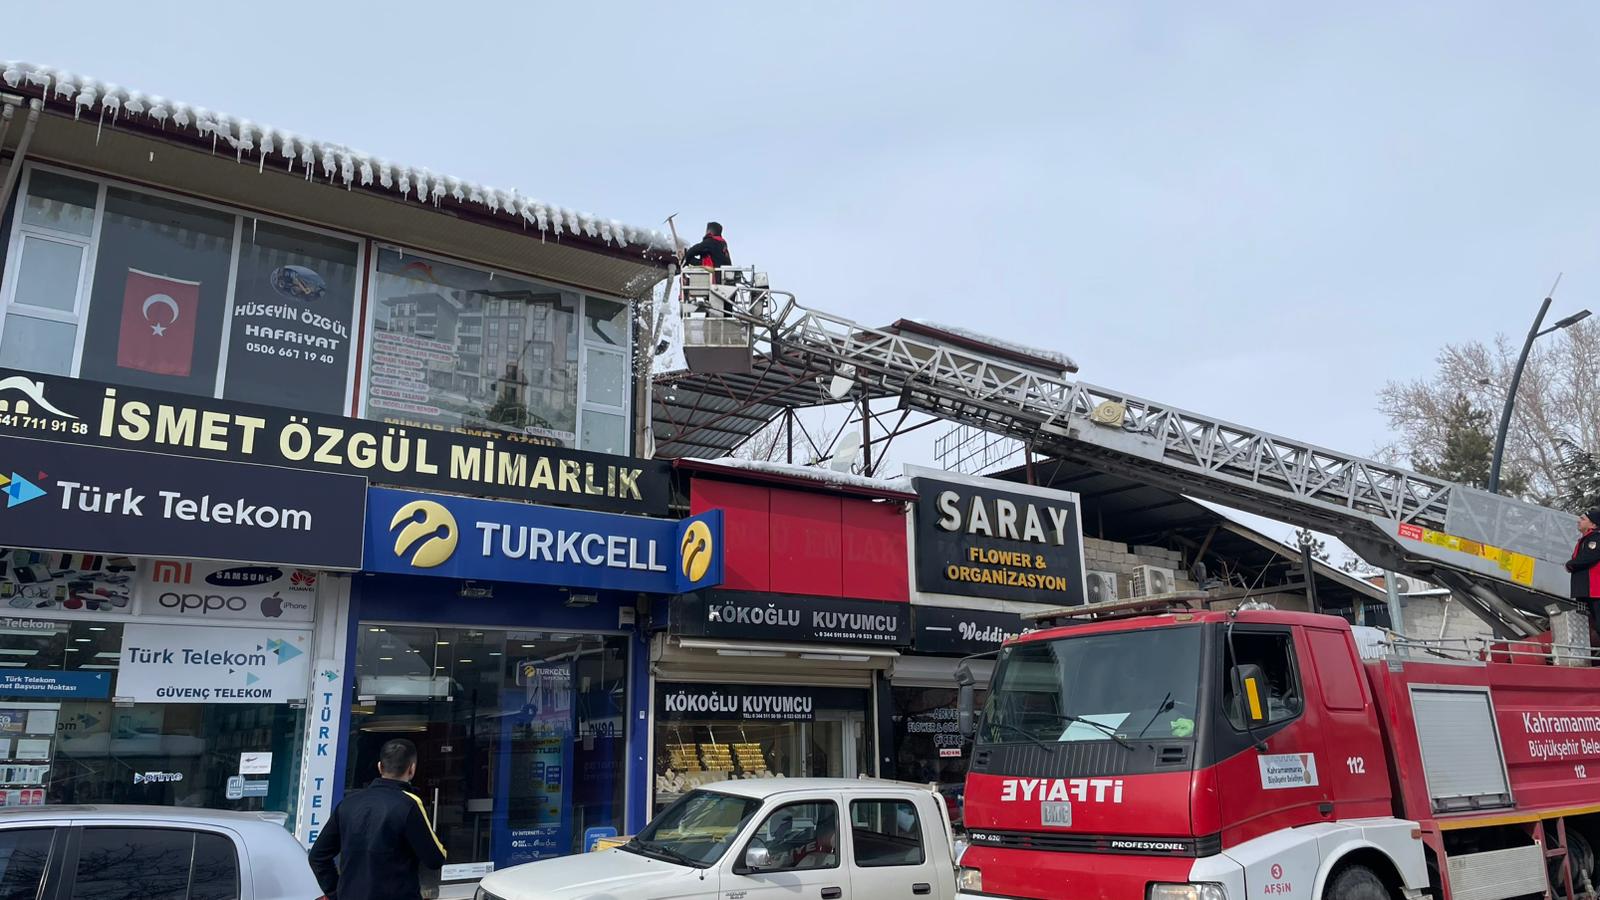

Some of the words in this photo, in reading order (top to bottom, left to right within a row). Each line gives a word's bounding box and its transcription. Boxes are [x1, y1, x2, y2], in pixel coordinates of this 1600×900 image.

[234, 302, 297, 320] HÜSEYİN
[301, 309, 348, 339] ÖZGÜL
[245, 324, 340, 350] HAFRİYAT
[246, 343, 275, 354] 0506
[278, 348, 299, 359] 667
[304, 351, 317, 361] 19
[320, 355, 334, 364] 40
[0, 414, 18, 427] 41
[22, 416, 47, 429] 711
[51, 420, 67, 432] 91
[71, 422, 88, 434] 58
[99, 387, 266, 454] İSMET
[279, 415, 438, 475] ÖZGÜL
[450, 441, 643, 501] MİMARLIK
[56, 480, 145, 518] Türk
[158, 489, 312, 532] Telekom
[936, 490, 1068, 546] SARAY
[475, 521, 667, 572] TURKCELL
[969, 547, 1031, 568] FLOWER
[1035, 555, 1046, 569] &
[947, 565, 1067, 592] ORGANİZASYON
[283, 601, 308, 610] iPhone
[5, 618, 55, 629] Telekom
[708, 600, 801, 626] KÖKOĞLU
[812, 611, 897, 632] KUYUMCU
[958, 621, 1012, 642] Weddin
[128, 647, 174, 665] Türk
[182, 648, 266, 666] Telekom
[24, 676, 56, 684] Telekom
[536, 668, 571, 676] TURKCELL
[156, 685, 210, 701] GÜVENÇ
[214, 688, 272, 698] TELEKOM
[665, 691, 738, 712] KÖKOĞLU
[743, 695, 812, 713] KUYUMCU
[317, 693, 332, 756] TÜRK
[1529, 740, 1579, 760] Büyükşehir
[1347, 756, 1365, 774] 112
[1574, 765, 1586, 778] 112
[144, 772, 182, 783] prime
[1112, 840, 1185, 851] PROFESYONEL
[1264, 882, 1291, 895] AFŞİN
